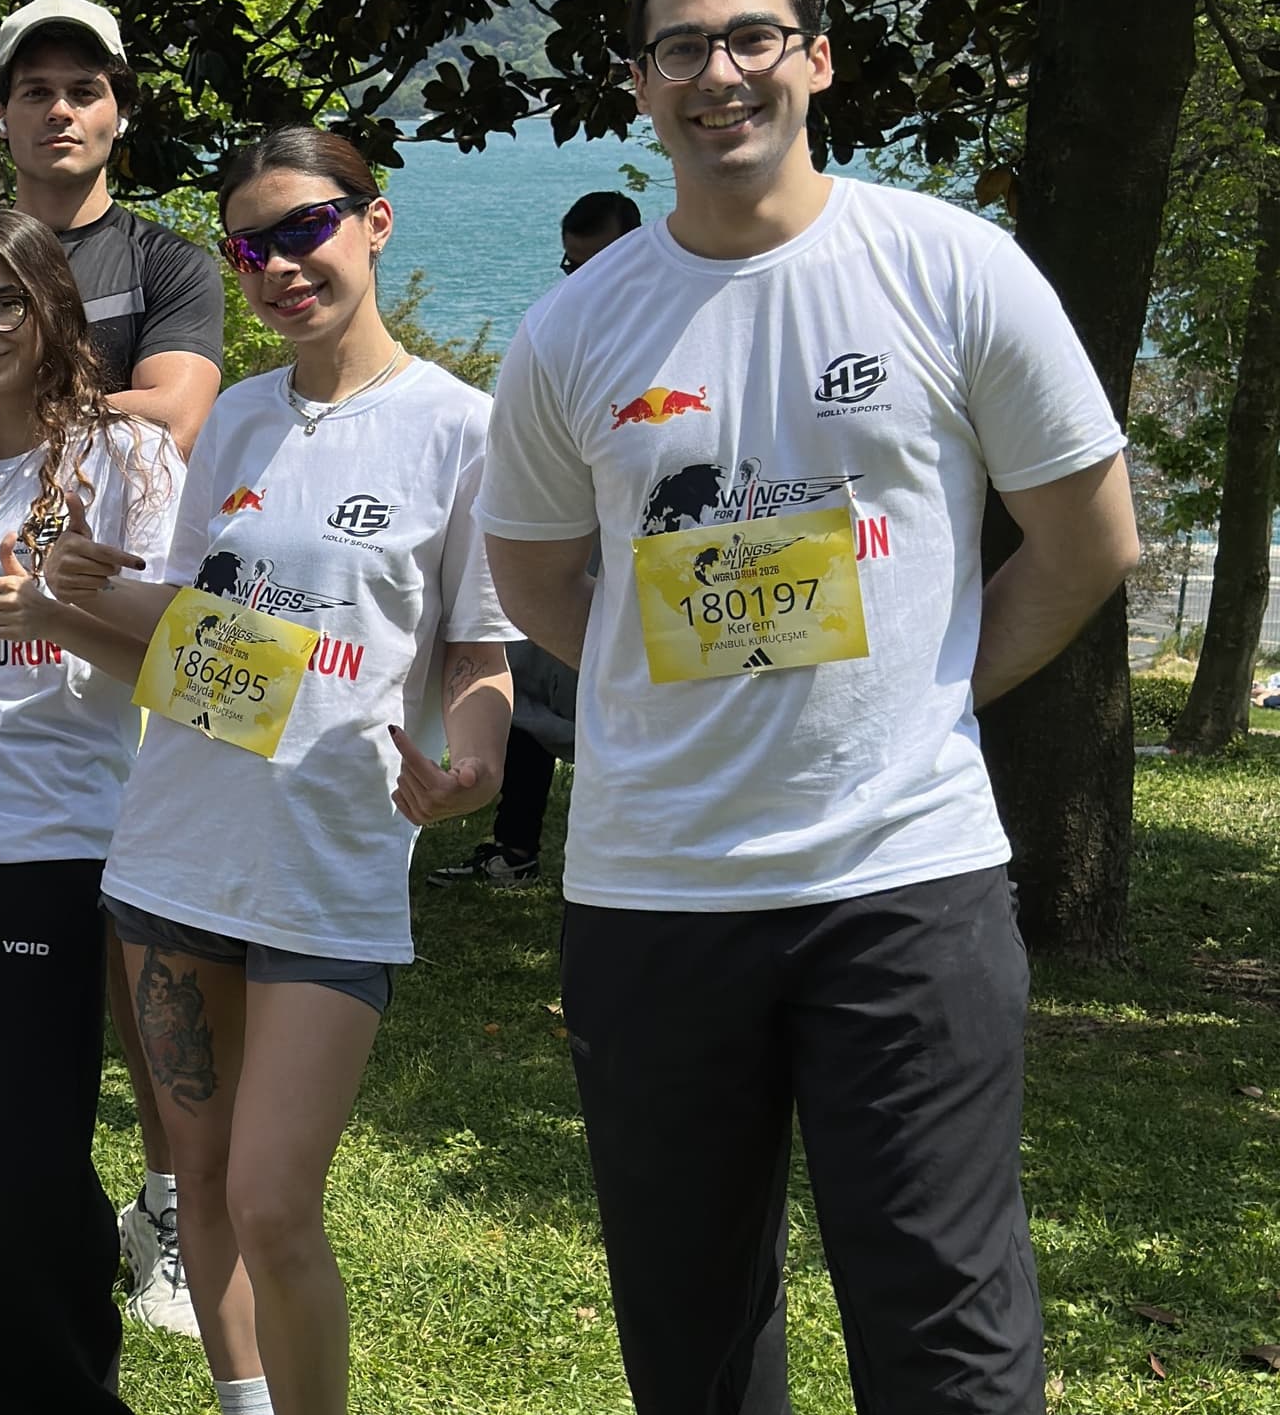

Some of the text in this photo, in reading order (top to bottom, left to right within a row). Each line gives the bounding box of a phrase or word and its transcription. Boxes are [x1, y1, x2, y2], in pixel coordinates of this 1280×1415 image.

[816, 403, 892, 419] HOLLY SPORTS
[719, 479, 807, 510] WINGS
[713, 509, 734, 521] FOR
[321, 533, 385, 554] HOLLY SPORTS
[722, 543, 773, 560] WINGS
[729, 555, 759, 570] LIFE
[759, 565, 780, 577] 2026
[237, 578, 306, 610] WINGS
[679, 578, 819, 627] 180197
[727, 619, 776, 636] Kerem
[748, 630, 809, 646] KURUÇEŞME
[233, 648, 249, 661] 2026
[173, 645, 269, 702] 186495
[216, 693, 237, 705] nur
[1, 939, 50, 956] VOID
